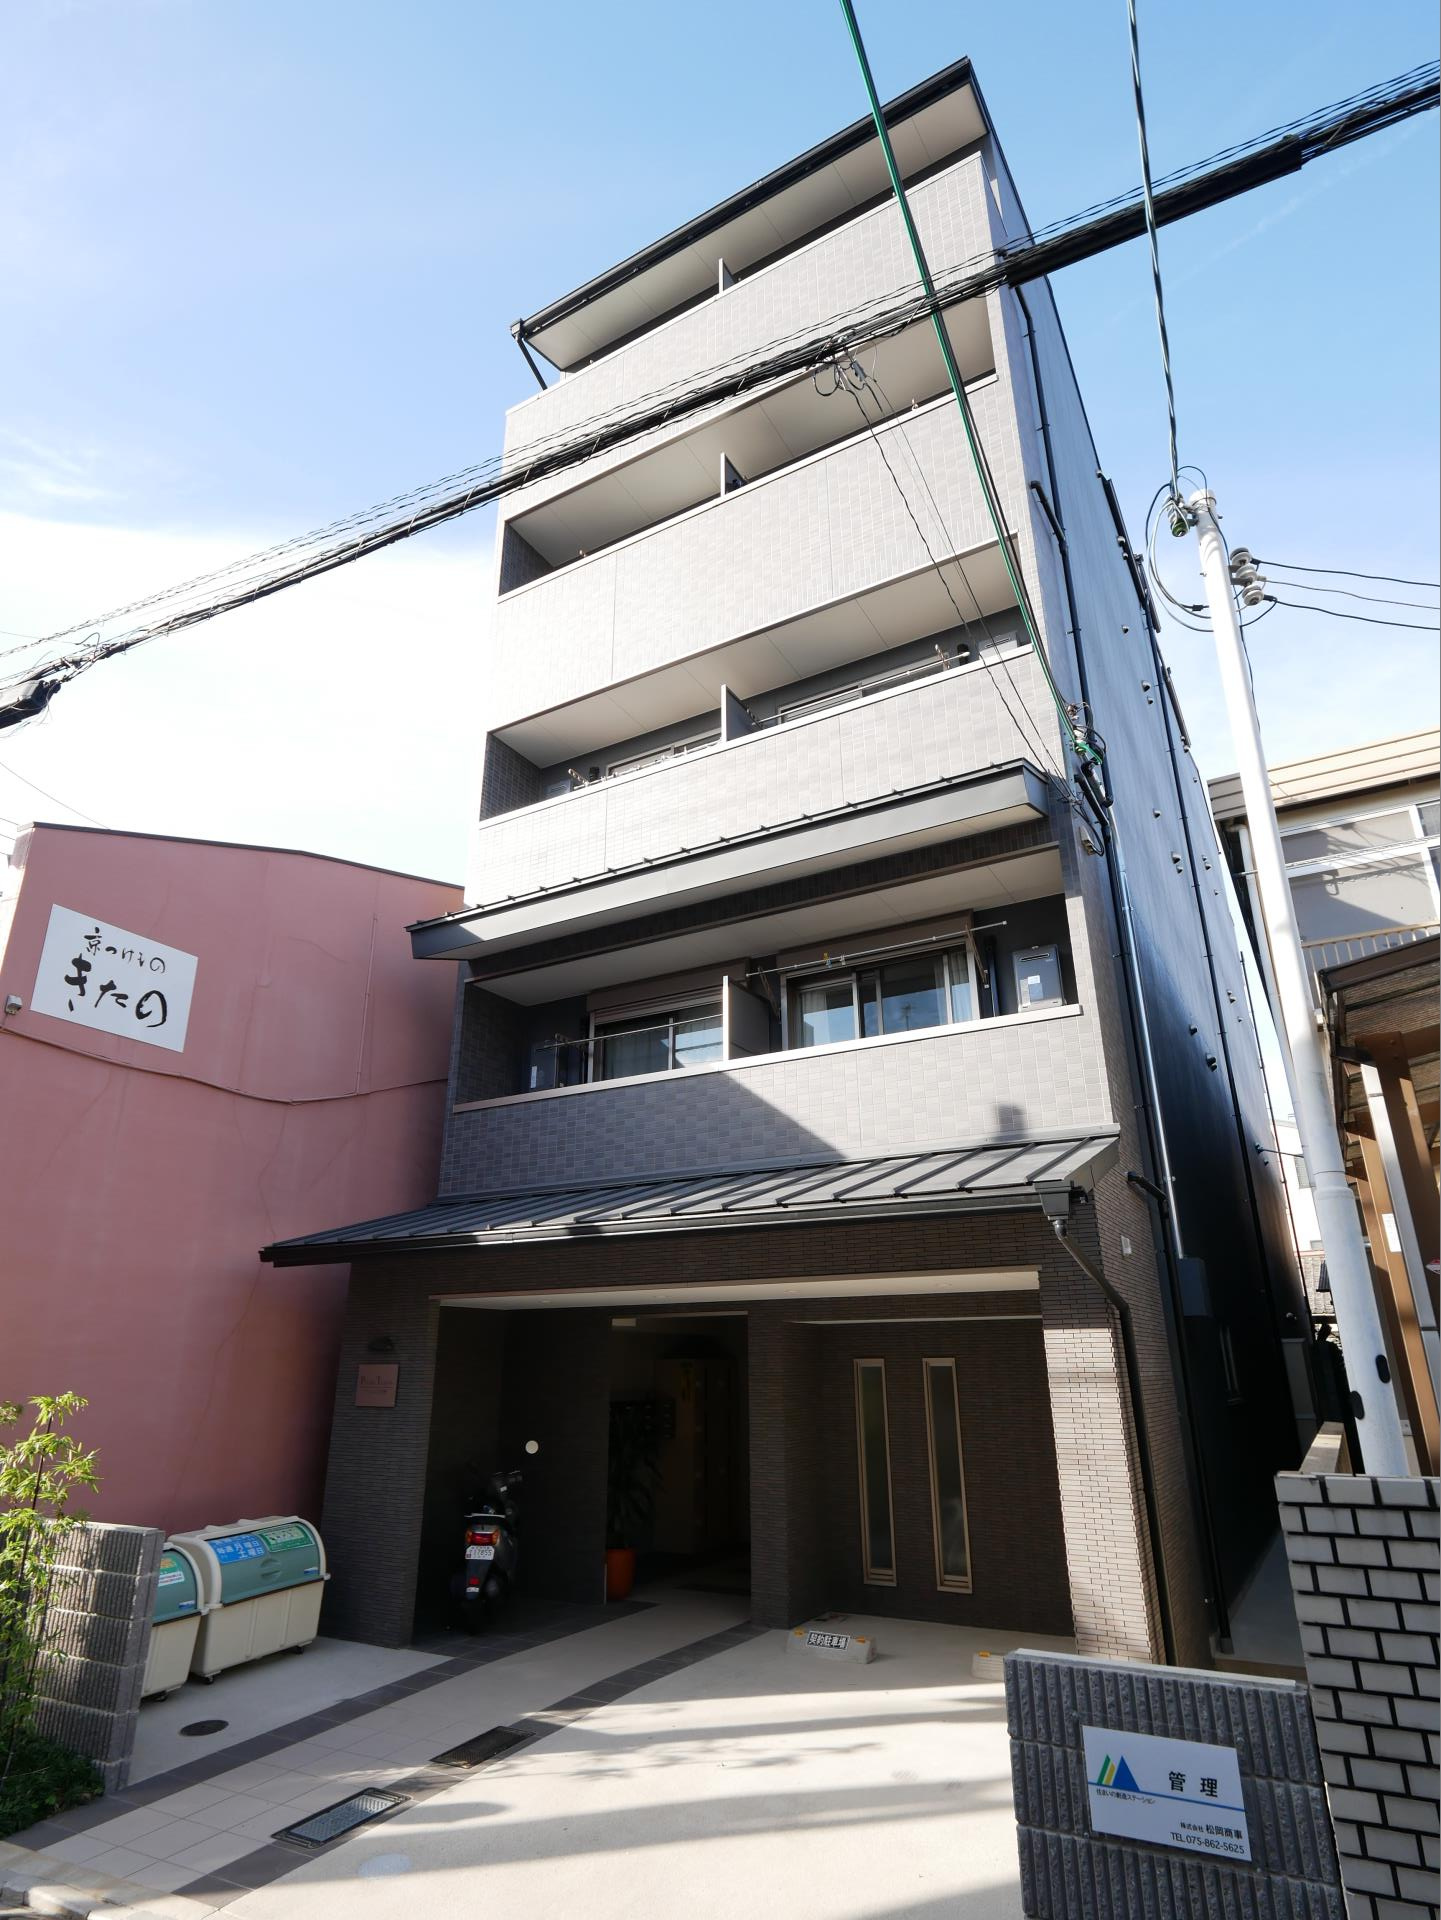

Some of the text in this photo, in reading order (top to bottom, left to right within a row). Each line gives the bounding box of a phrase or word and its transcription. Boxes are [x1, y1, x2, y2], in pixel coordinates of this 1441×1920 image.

[84, 926, 166, 974] 京つけもの
[64, 953, 168, 1028] きたの
[808, 1633, 847, 1648] 契約駐車場
[1168, 1770, 1218, 1798] 管理
[1186, 1834, 1245, 1854] 075-862-5625
